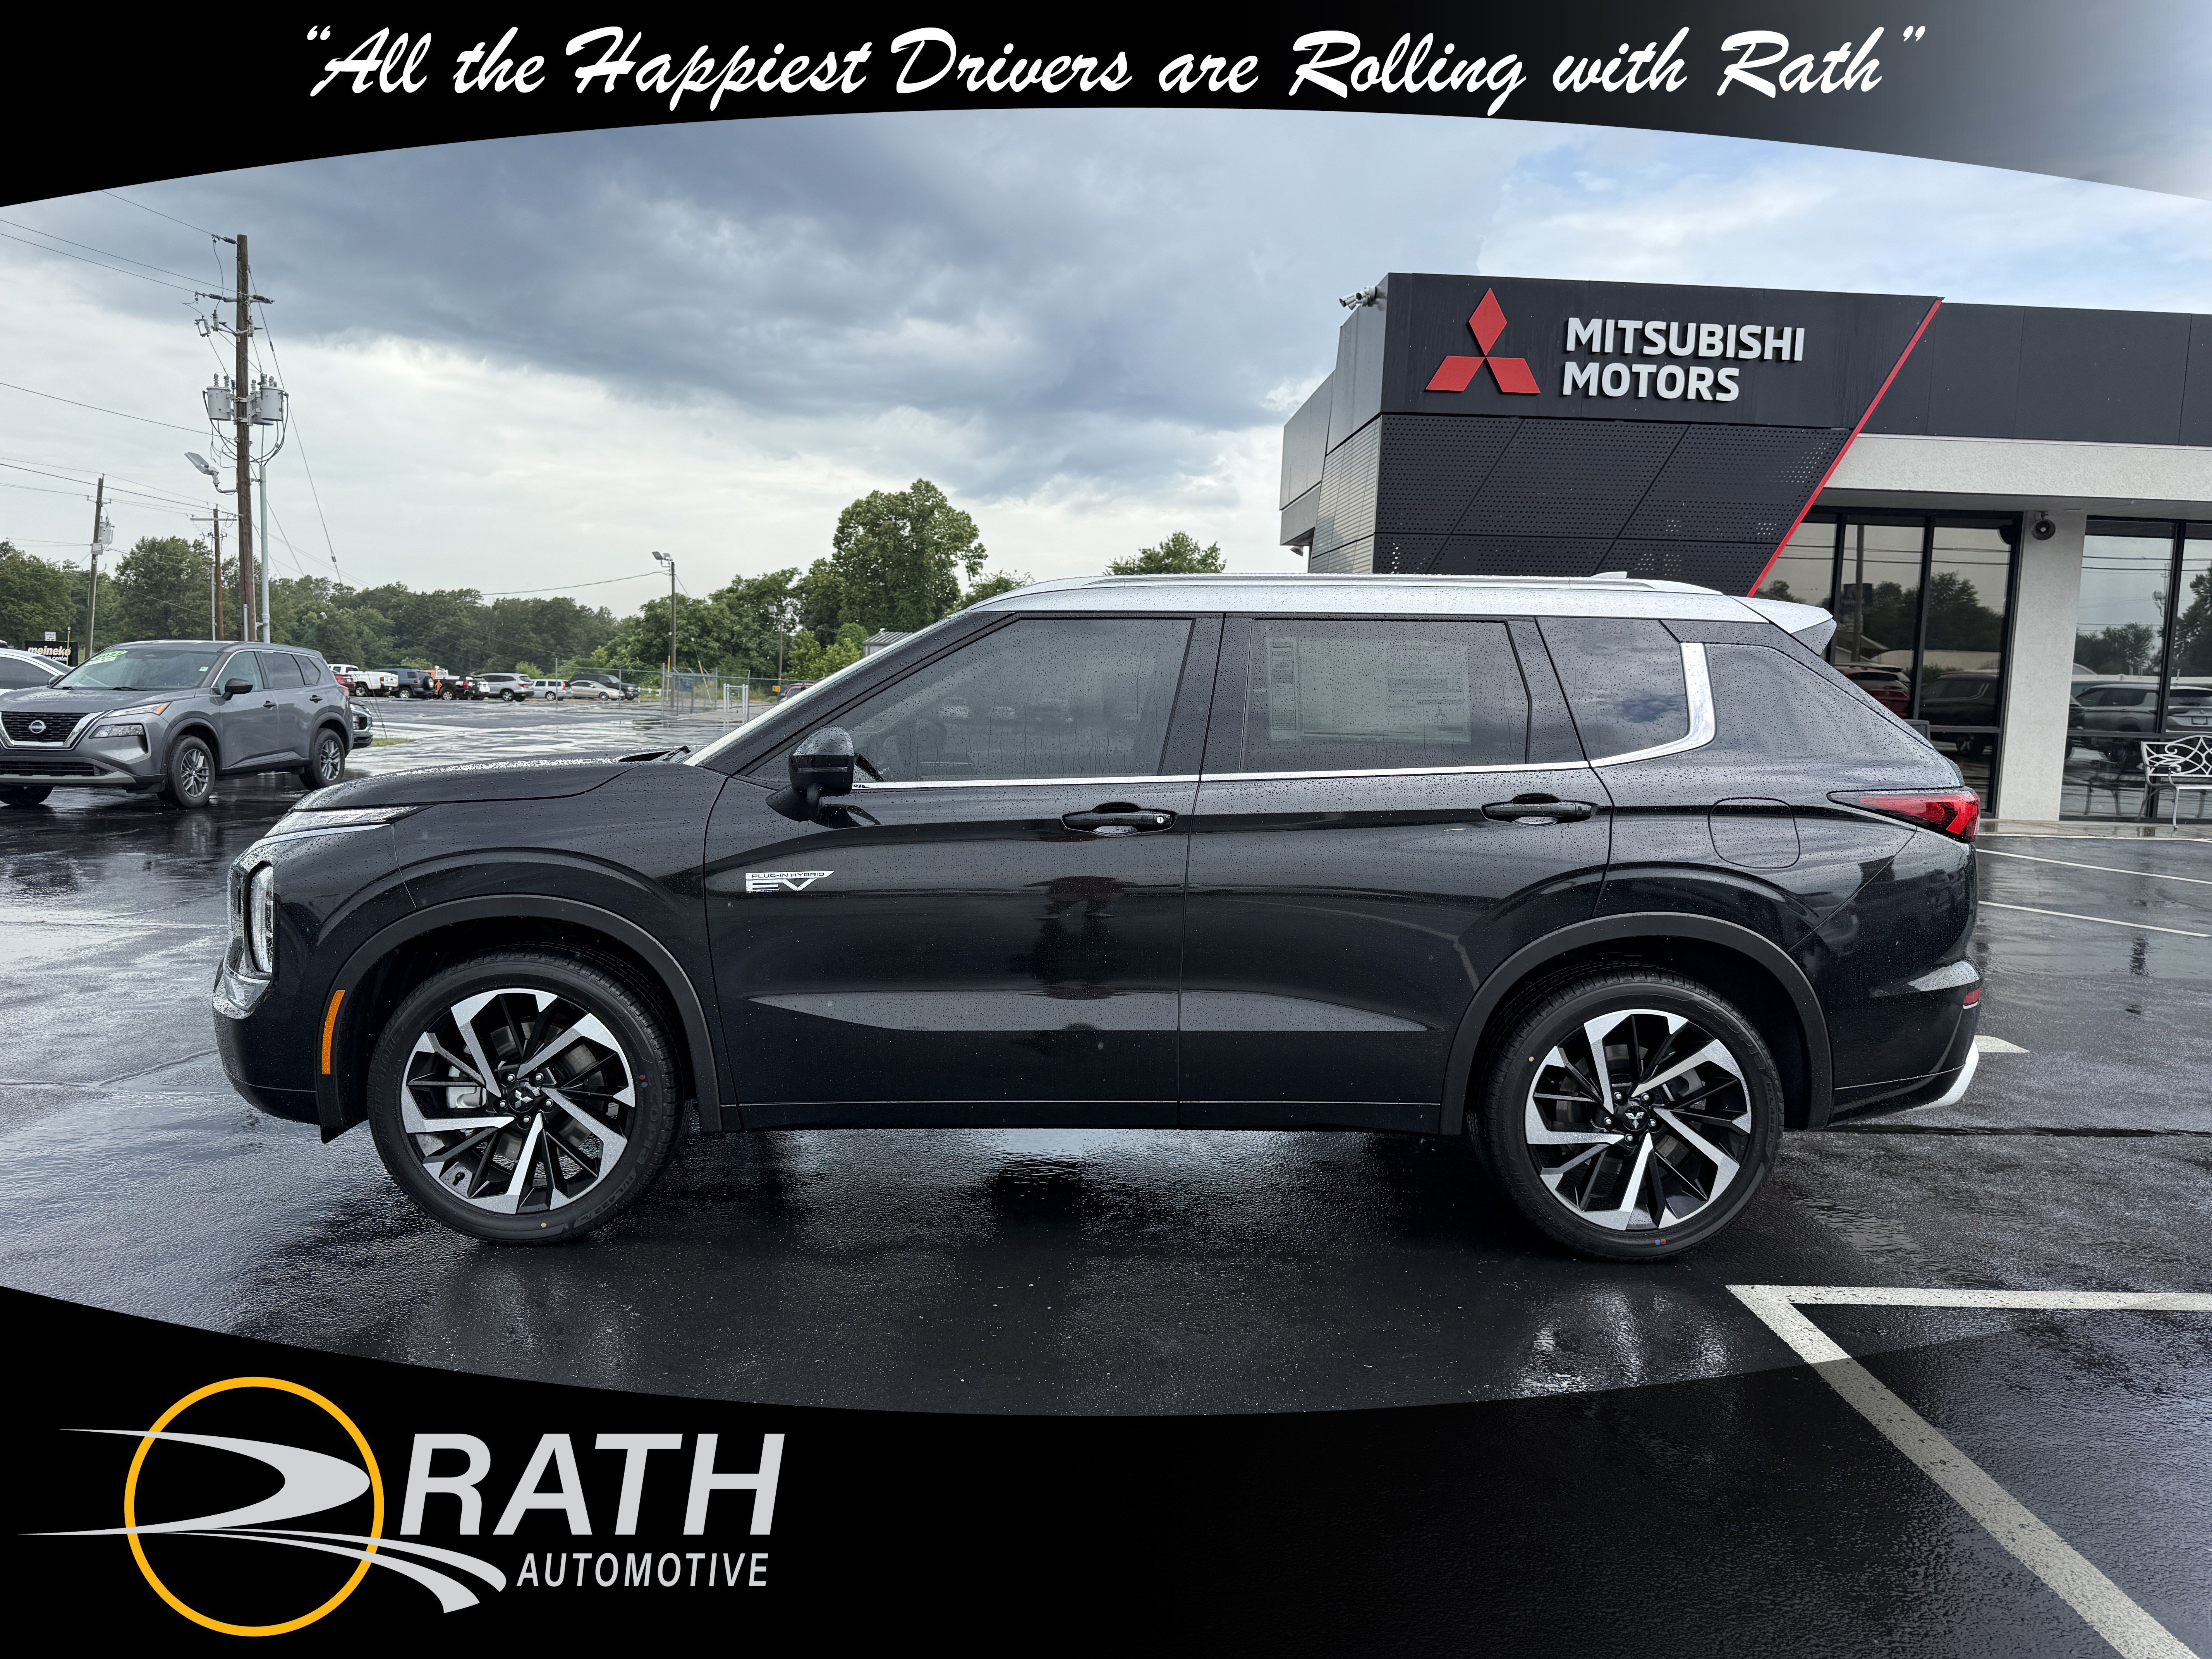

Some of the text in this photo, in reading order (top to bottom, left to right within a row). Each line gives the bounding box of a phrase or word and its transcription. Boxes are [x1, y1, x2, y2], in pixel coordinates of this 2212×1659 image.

[1566, 318, 1805, 361] MITSUBISHI
[1563, 362, 1739, 401] MOTORS
[28, 646, 71, 656] meineke
[746, 878, 817, 893] EV
